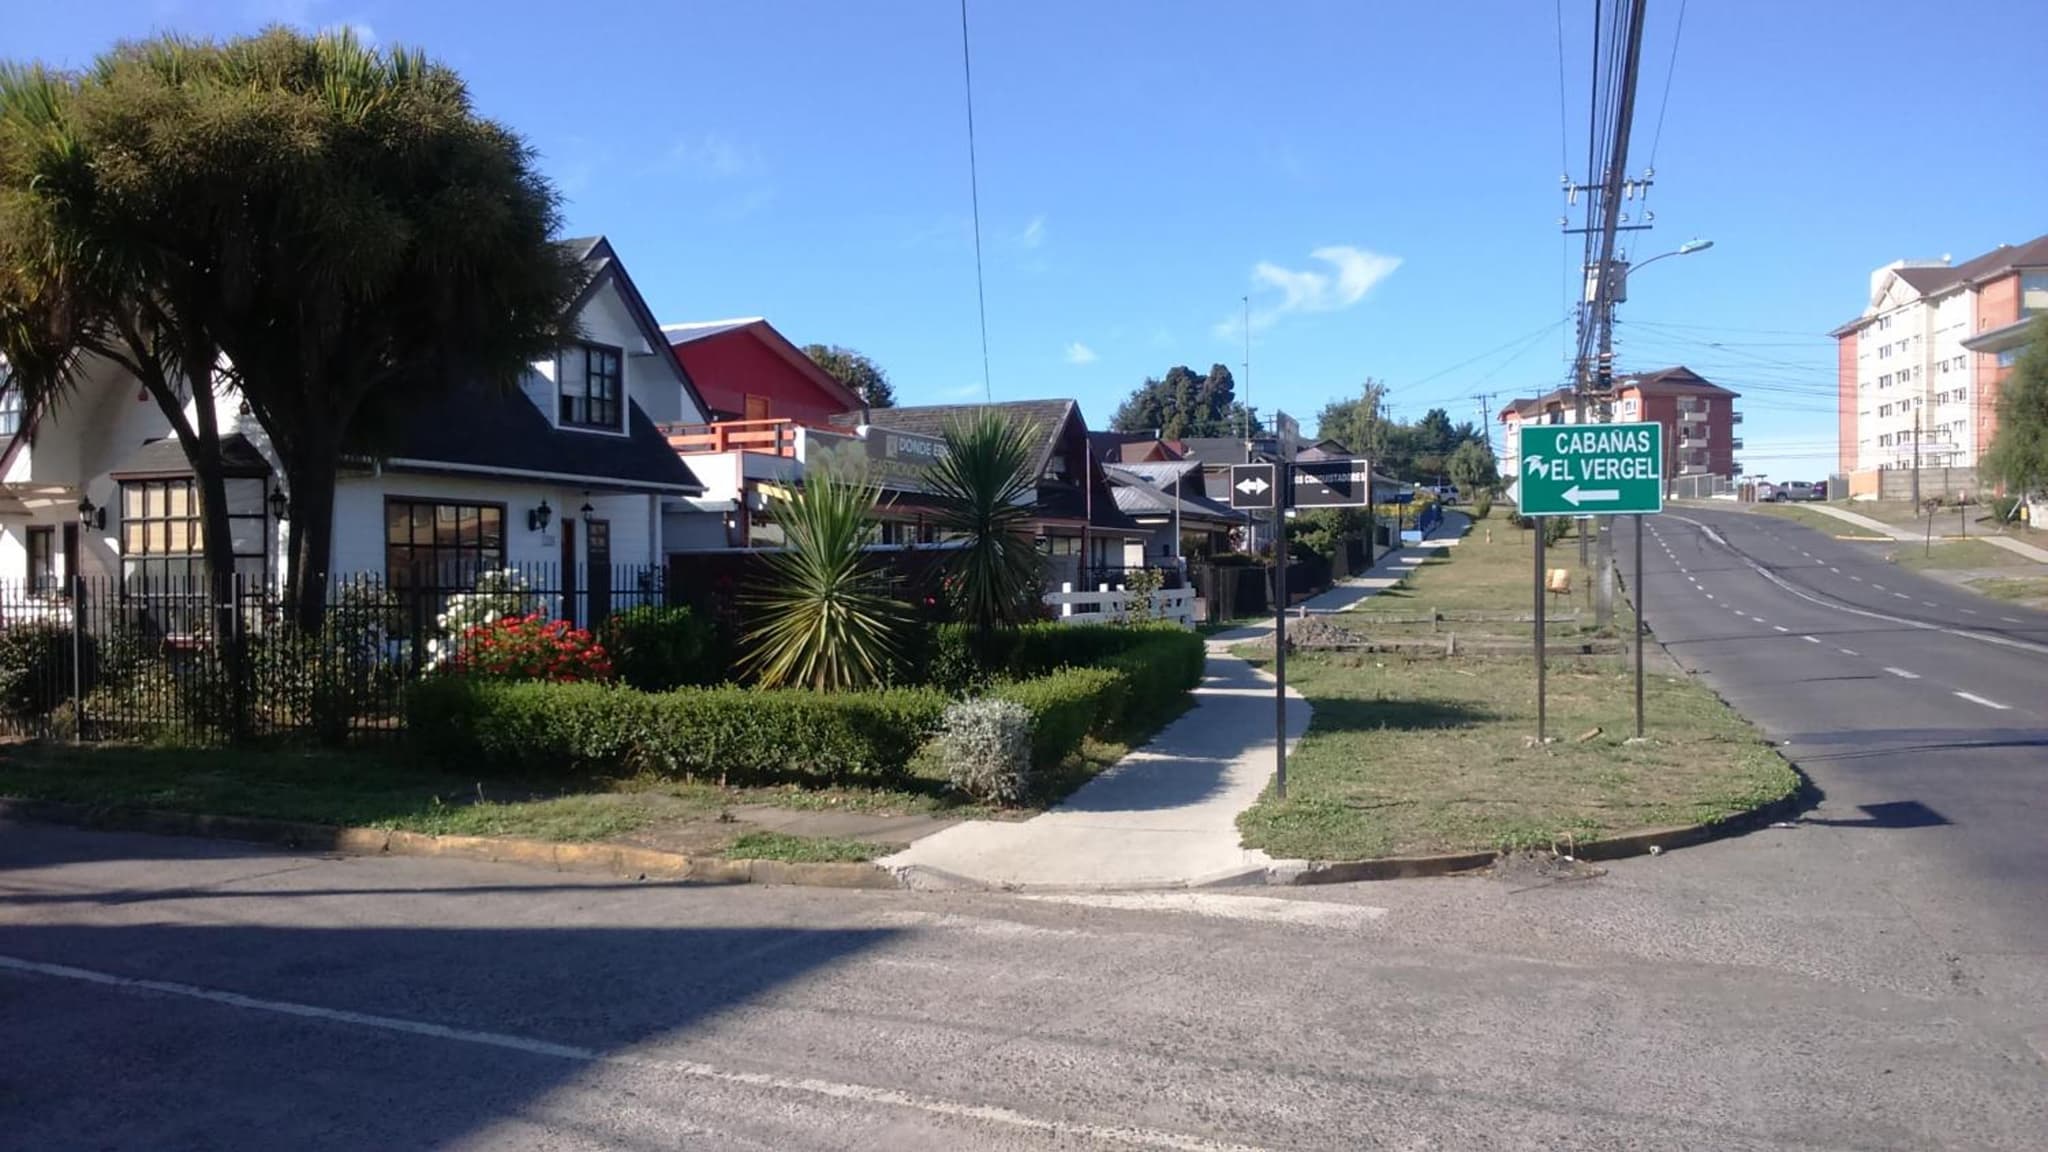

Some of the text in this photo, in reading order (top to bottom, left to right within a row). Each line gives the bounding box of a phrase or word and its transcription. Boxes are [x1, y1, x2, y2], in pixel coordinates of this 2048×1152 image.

[899, 438, 932, 455] DONDE
[1555, 429, 1650, 454] CABAÑAS
[1551, 457, 1658, 481] EL VERGEL
